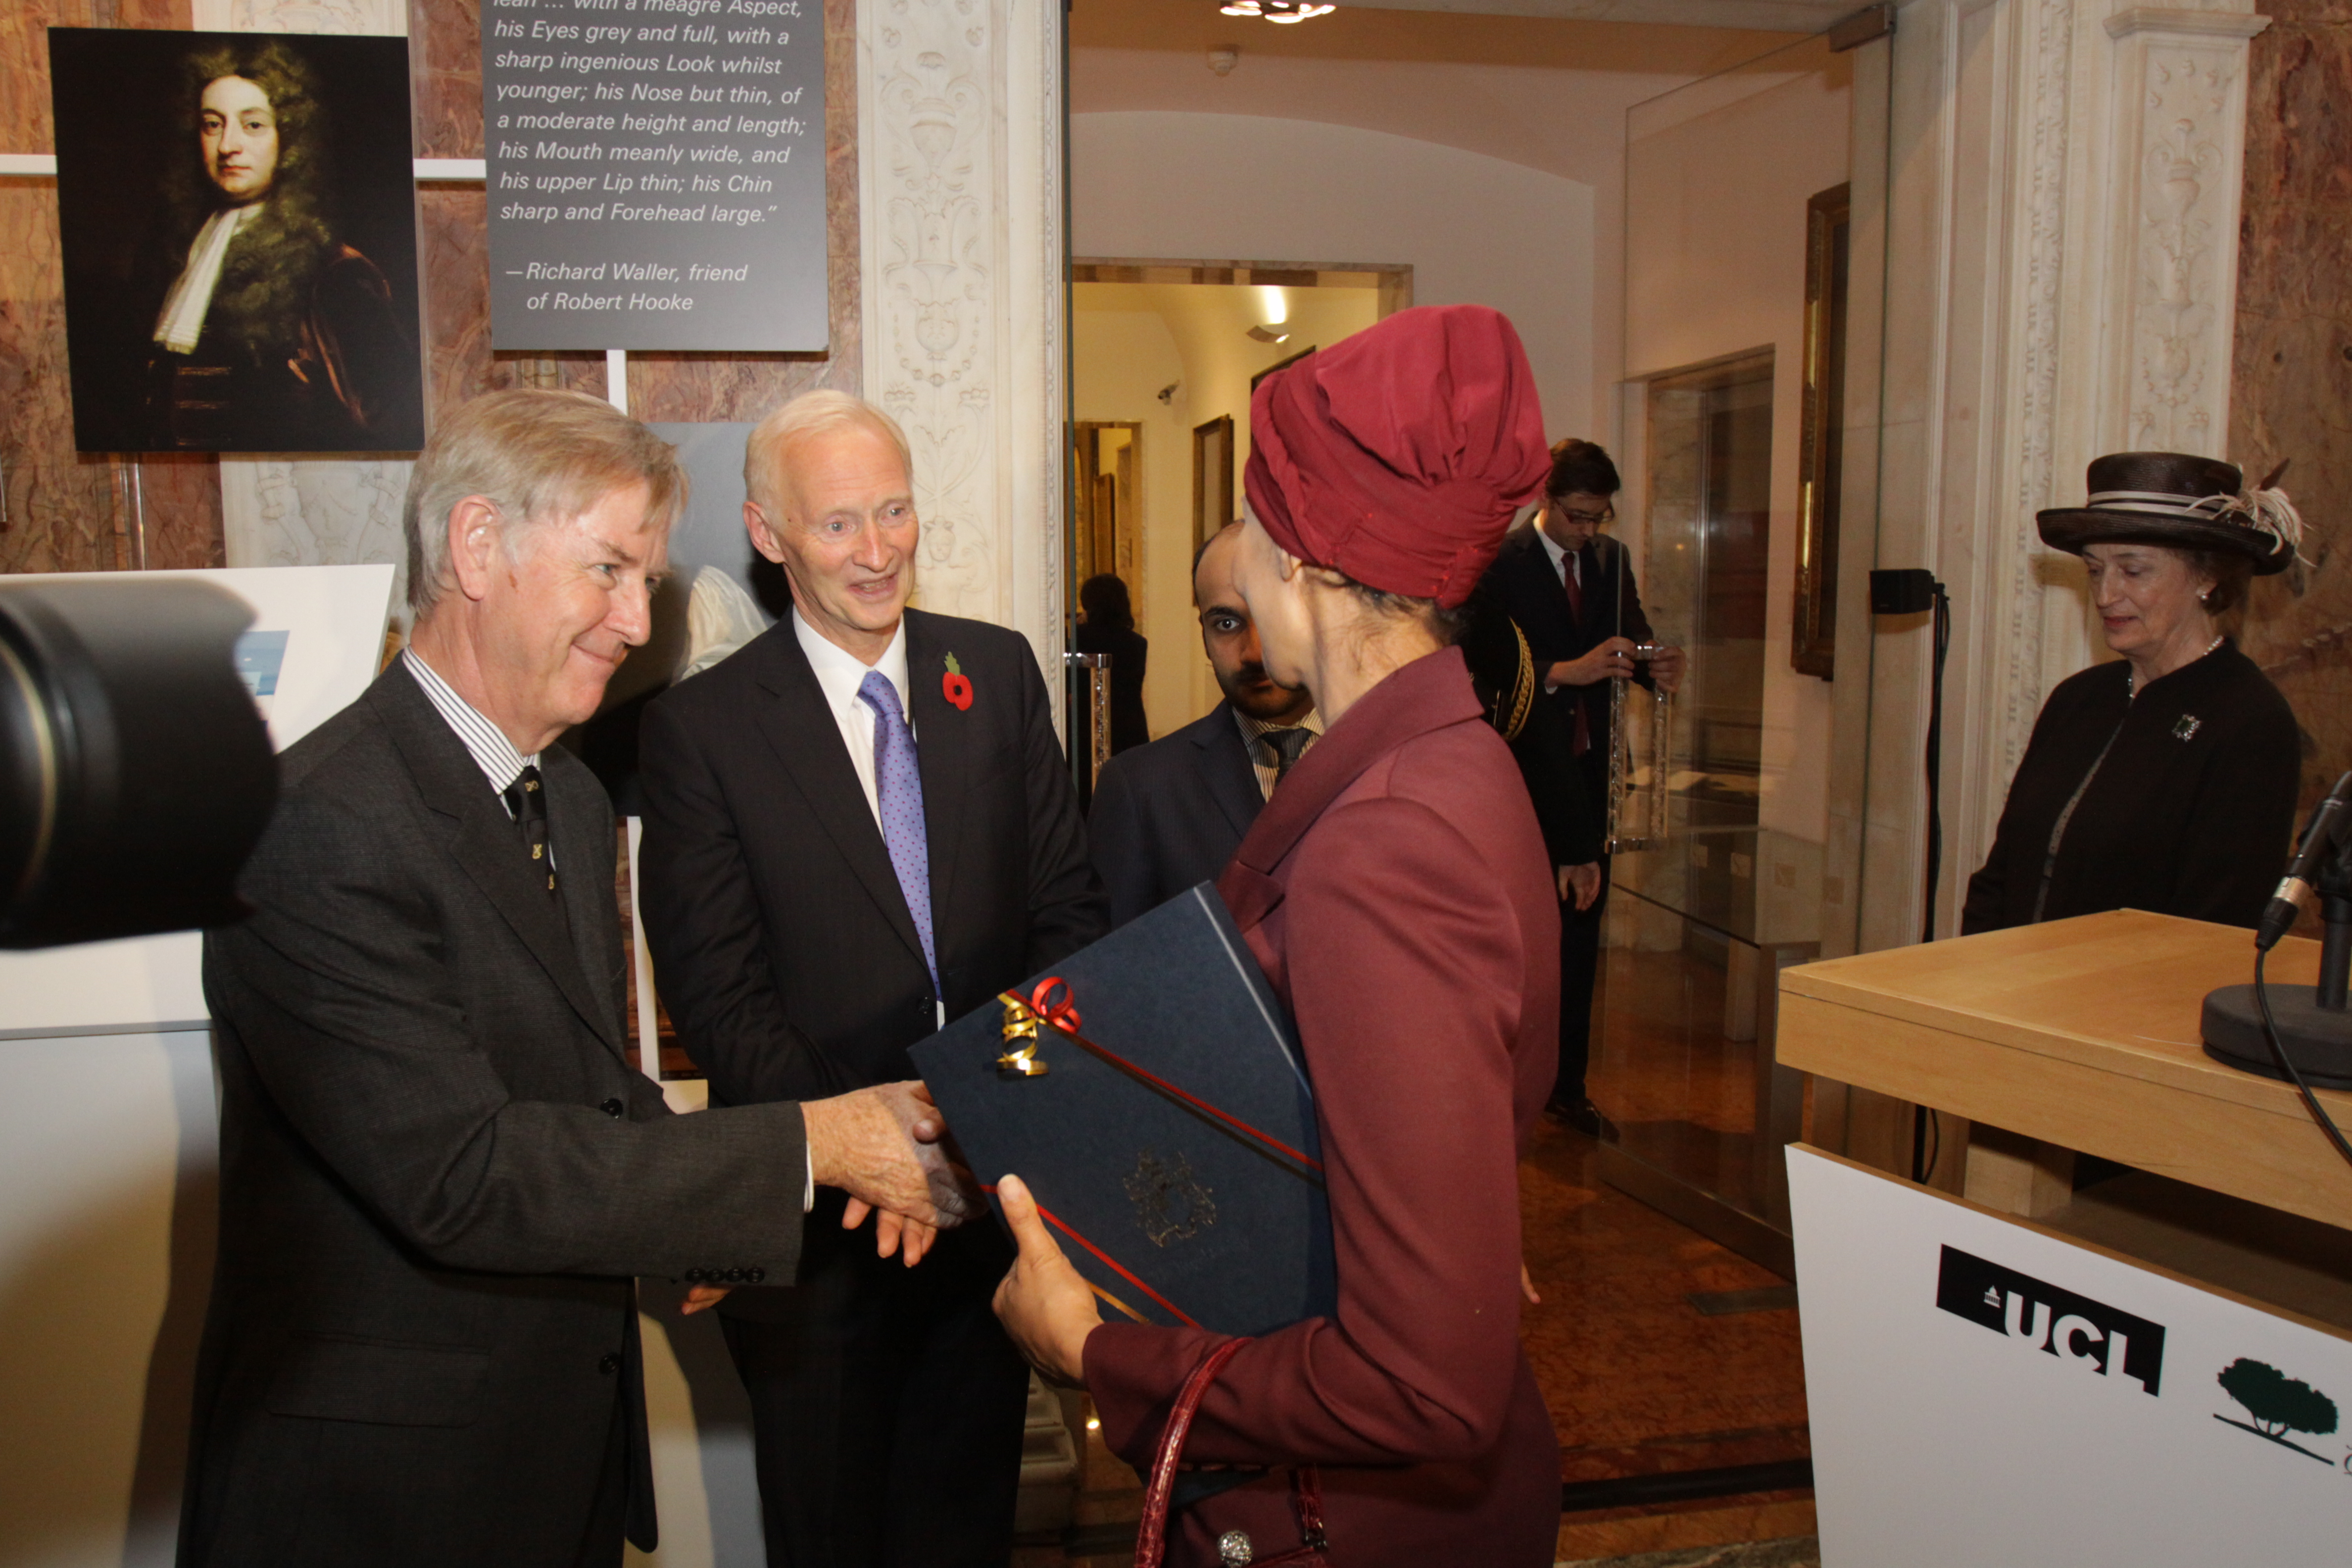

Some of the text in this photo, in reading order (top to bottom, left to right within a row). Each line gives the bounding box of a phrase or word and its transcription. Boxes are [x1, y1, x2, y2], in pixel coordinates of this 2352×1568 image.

[625, 0, 637, 10] a
[644, 0, 721, 16] meagre
[727, 0, 801, 18] Aspect,
[494, 19, 789, 45] his Eyes grey and full, with a
[495, 49, 783, 74] sharp ingenious Look whilst
[497, 82, 803, 106] younger; his Nose but thin, of
[496, 111, 806, 138] a moderate height and length;
[498, 141, 791, 165] his Mouth meanly wide, and
[499, 171, 772, 194] his upper Lip thin; his Chin
[500, 201, 558, 223] sharp
[564, 203, 605, 220] and
[610, 202, 706, 221] Forehead
[613, 263, 680, 283] Waller,
[689, 263, 748, 282] friend
[527, 292, 693, 310] of Robert Hooke
[2004, 1289, 2146, 1393] UCL
